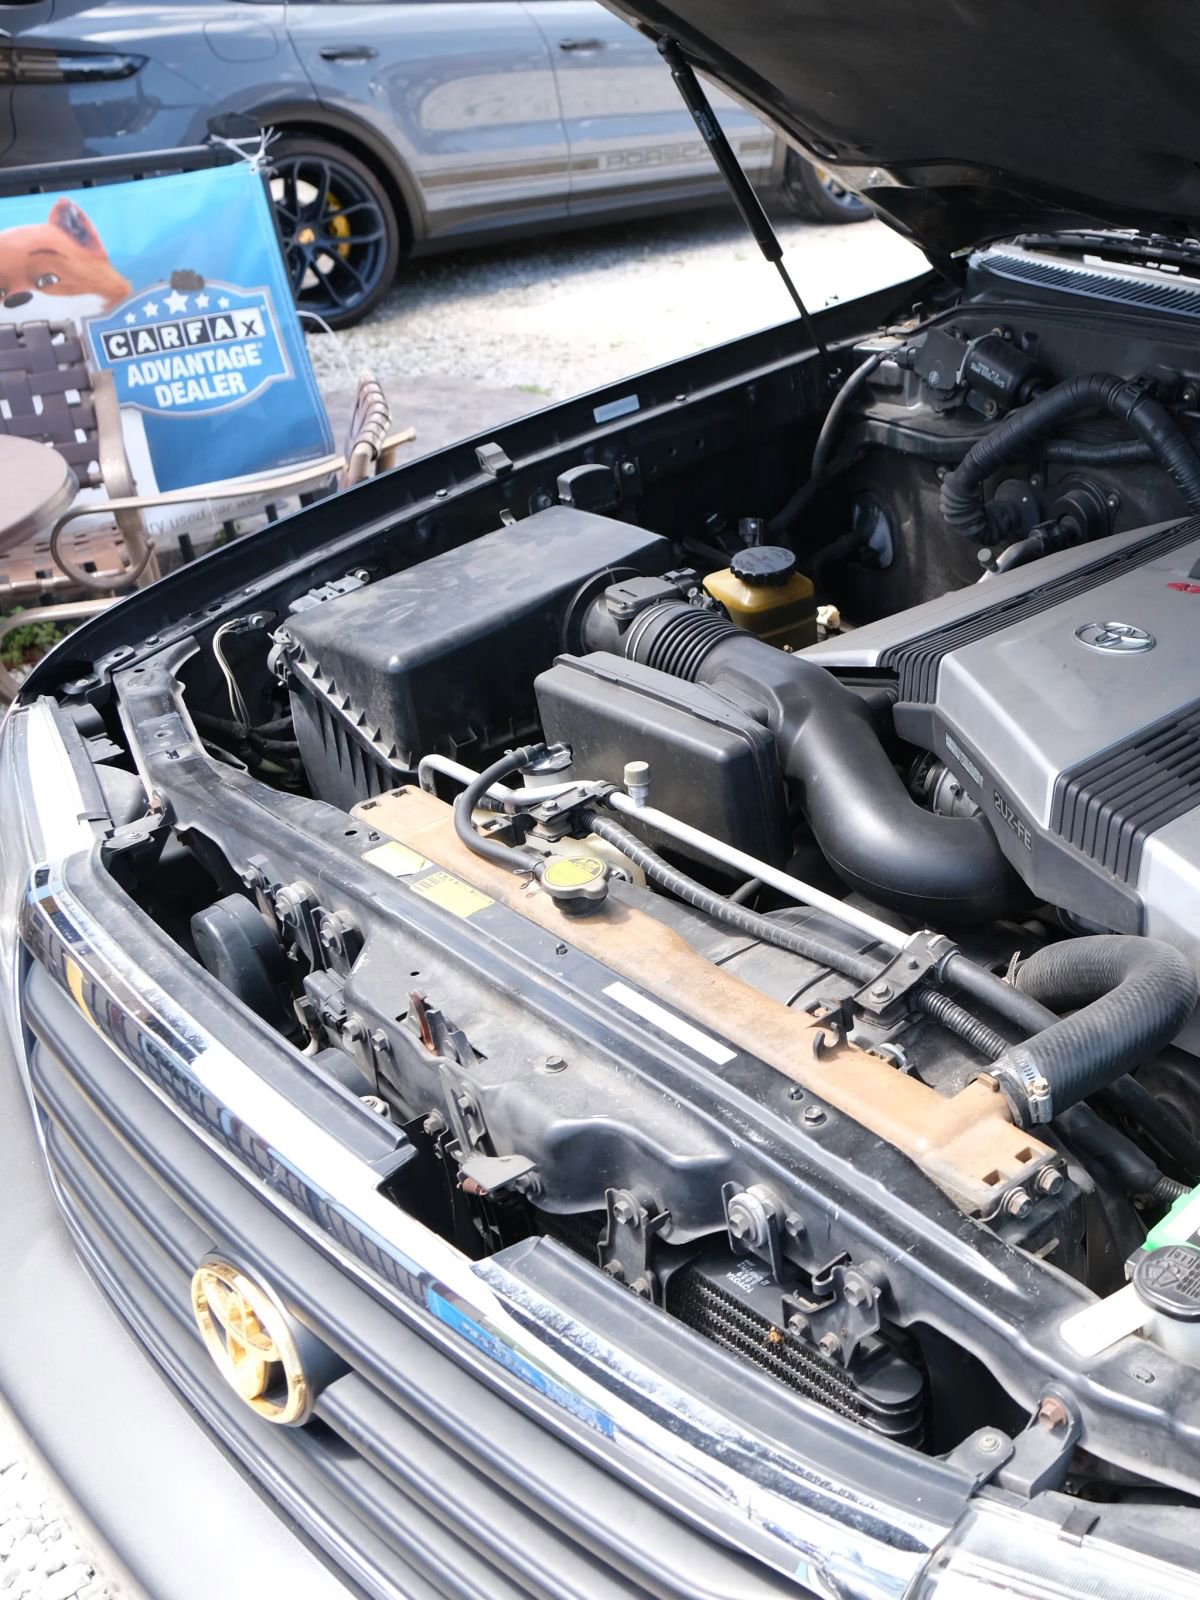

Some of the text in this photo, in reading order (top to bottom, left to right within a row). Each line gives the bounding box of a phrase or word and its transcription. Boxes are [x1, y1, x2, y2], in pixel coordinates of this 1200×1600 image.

[107, 313, 261, 358] CARFAX
[127, 344, 263, 388] ADVANTAGE
[154, 371, 248, 408] DEALER
[994, 790, 1032, 852] 2UZ-FE
